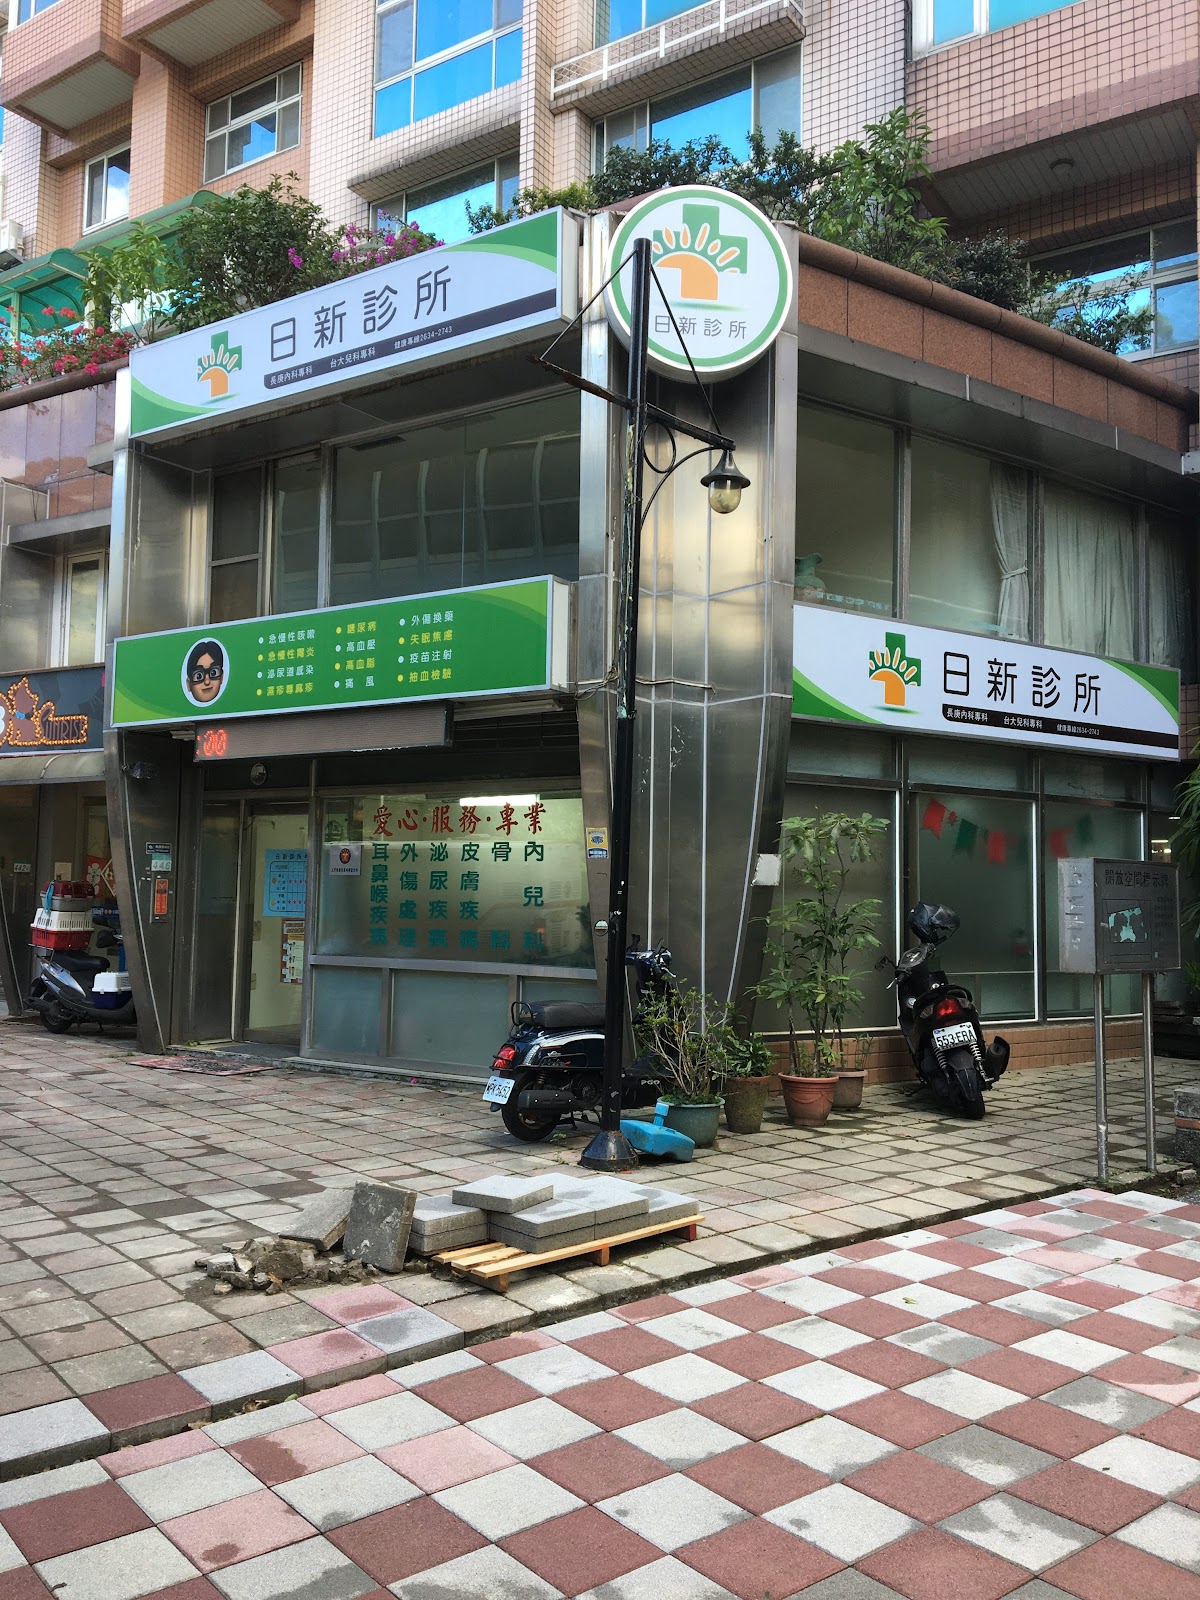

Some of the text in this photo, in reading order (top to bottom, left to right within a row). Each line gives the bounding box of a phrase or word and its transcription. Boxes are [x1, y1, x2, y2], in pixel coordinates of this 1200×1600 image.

[270, 265, 452, 362] 日新診所
[654, 315, 748, 340] 日新診所
[330, 347, 376, 369] 台大兒科專科
[410, 610, 454, 626] 外傷換藥
[346, 621, 377, 635] 糖尿病
[410, 629, 453, 645] 失眠焦慮
[346, 639, 376, 652] 高血壓
[345, 657, 375, 671] 高血脂
[409, 649, 453, 664] 疫苗注射
[267, 664, 314, 679] 泌尿道感染
[408, 668, 452, 682] 抽血檢驗
[943, 651, 1101, 716] 日新診所
[1003, 716, 1043, 730] 台大兒科專科
[369, 842, 389, 946] 耳鼻喉疾病
